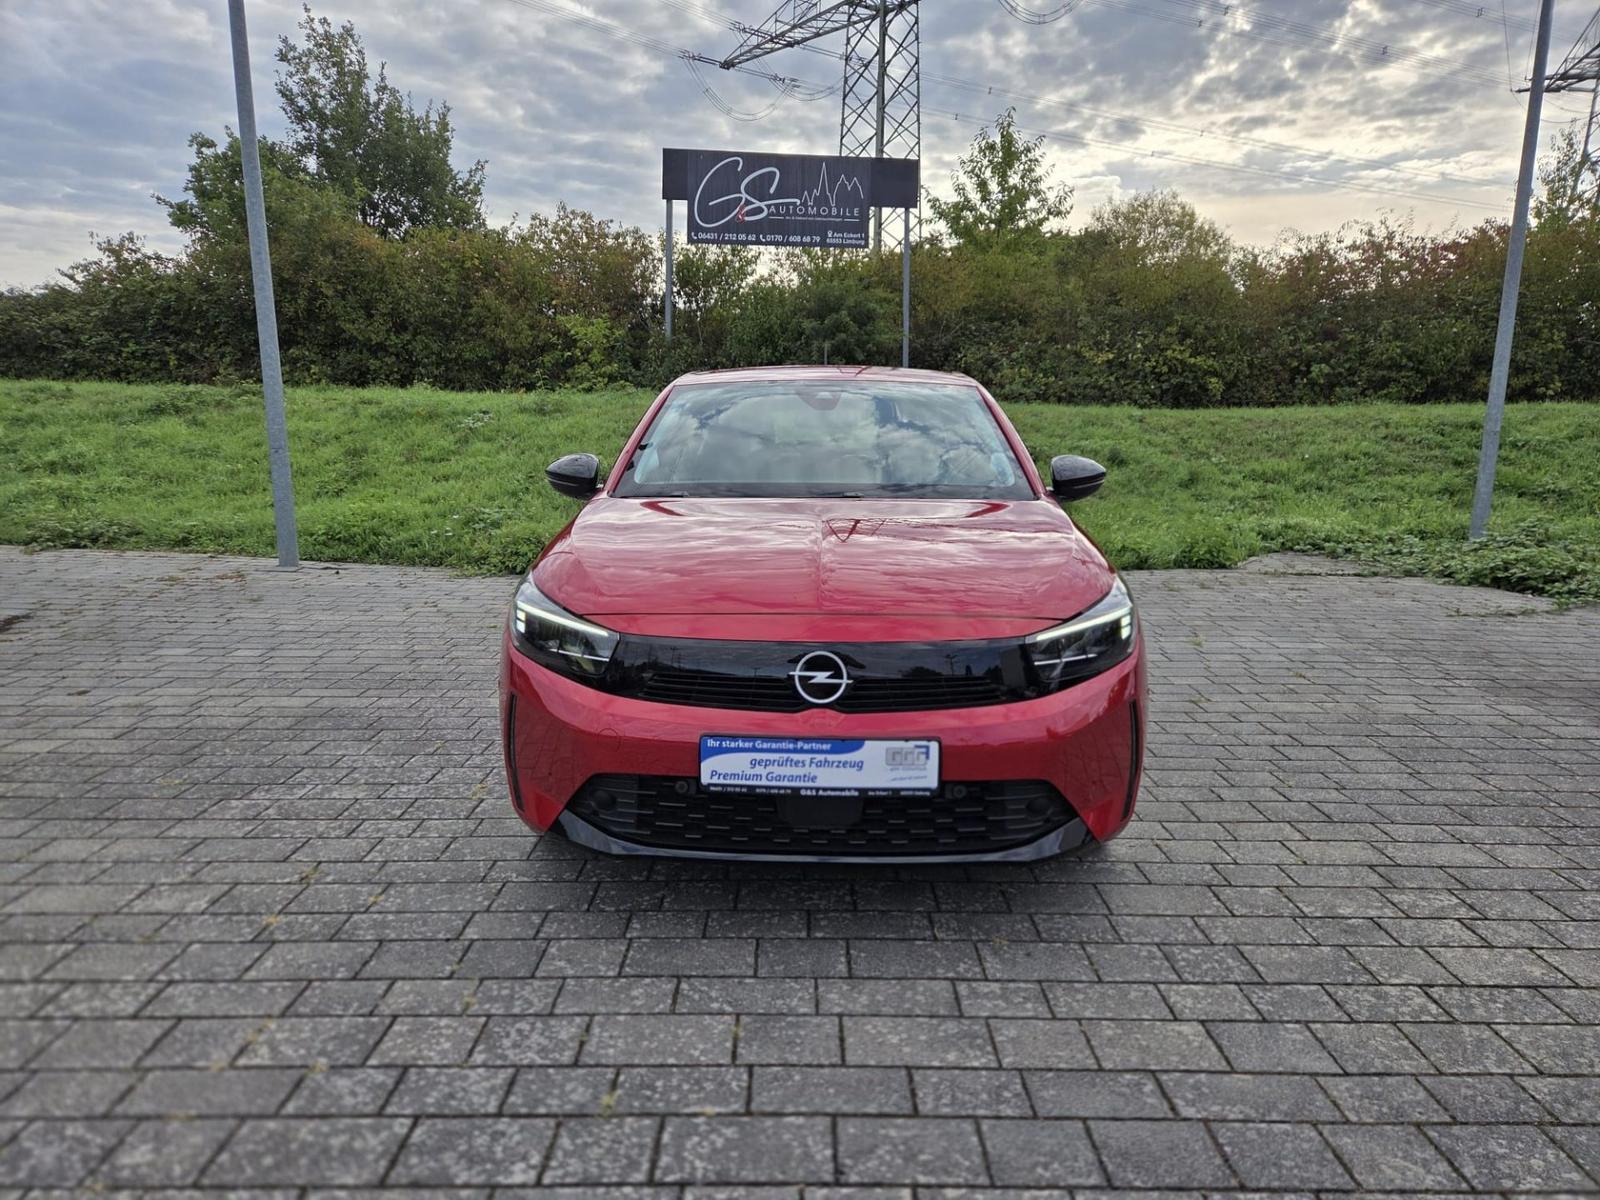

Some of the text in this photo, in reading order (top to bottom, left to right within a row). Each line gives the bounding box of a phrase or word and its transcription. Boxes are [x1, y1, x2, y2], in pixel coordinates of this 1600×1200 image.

[769, 204, 860, 217] AUTOMOBILE
[724, 232, 737, 241] 212
[737, 233, 747, 241] 05
[747, 233, 757, 241] 62
[766, 233, 783, 242] 0170
[788, 235, 801, 243] 608
[802, 235, 811, 243] 68
[811, 235, 821, 244] 79
[707, 739, 832, 750] Ihr starker Garantie-Partner
[749, 755, 865, 772] geprüftes Fahrzeug
[710, 769, 818, 784] Premium Garantie
